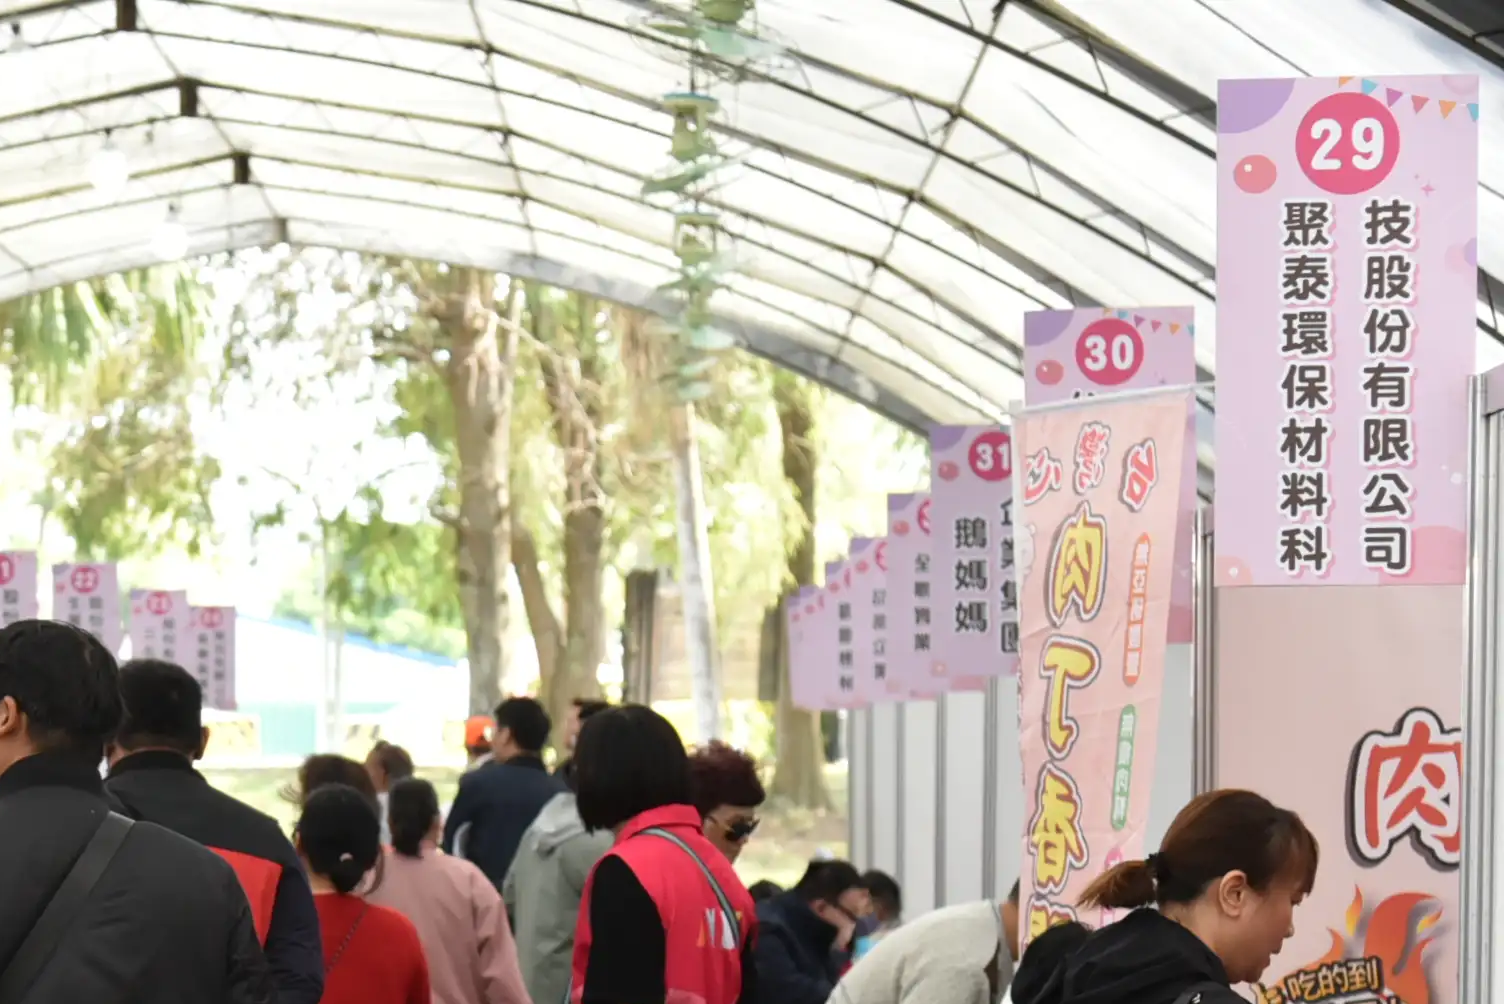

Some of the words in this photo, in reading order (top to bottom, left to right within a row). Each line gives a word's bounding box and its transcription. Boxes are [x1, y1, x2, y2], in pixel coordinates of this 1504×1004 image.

[1309, 117, 1385, 171] 29
[1083, 334, 1135, 372] 30
[1280, 201, 1329, 572] 聚泰環保材料科
[1362, 199, 1411, 572] 技股份有限公司
[975, 443, 1010, 471] 31
[955, 516, 988, 633] 鵝媽媽
[1356, 712, 1461, 863] 肉
